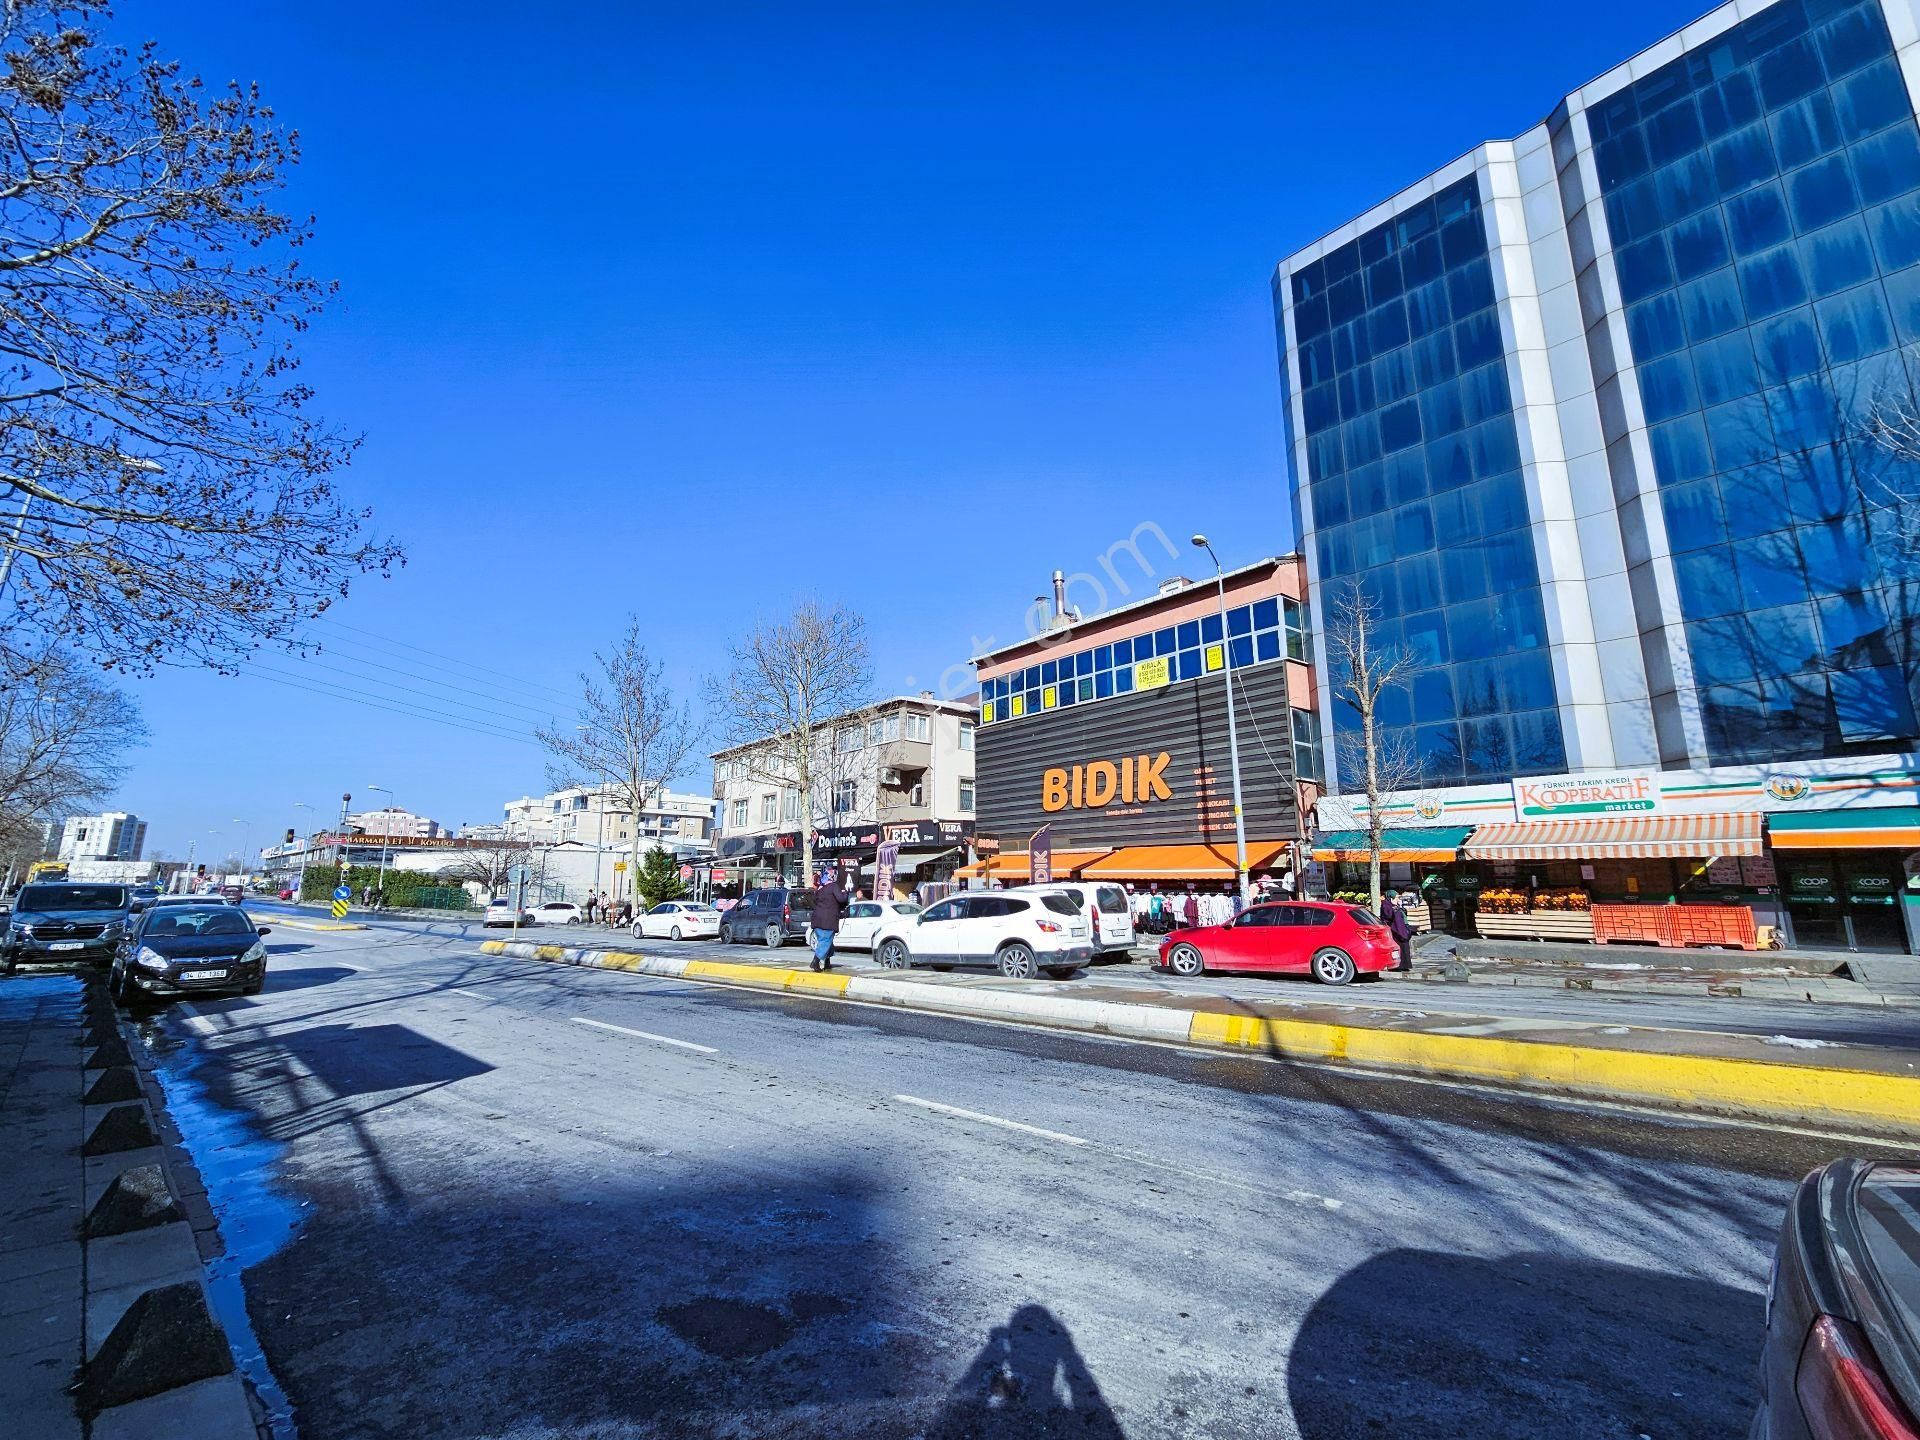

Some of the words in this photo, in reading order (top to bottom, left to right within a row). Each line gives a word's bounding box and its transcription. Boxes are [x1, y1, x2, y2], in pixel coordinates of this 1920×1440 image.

[1042, 752, 1173, 812] BIDIK
[1542, 780, 1574, 789] TÜRKİYE
[1577, 778, 1603, 787] TARIM
[1605, 775, 1630, 784] KREDİ
[1604, 801, 1647, 811] market
[939, 822, 962, 832] VERA
[883, 824, 920, 843] VERA
[818, 832, 856, 848] Domino's
[840, 859, 859, 867] VERA
[1799, 877, 1829, 886] KOOP
[1858, 878, 1890, 886] KOOP
